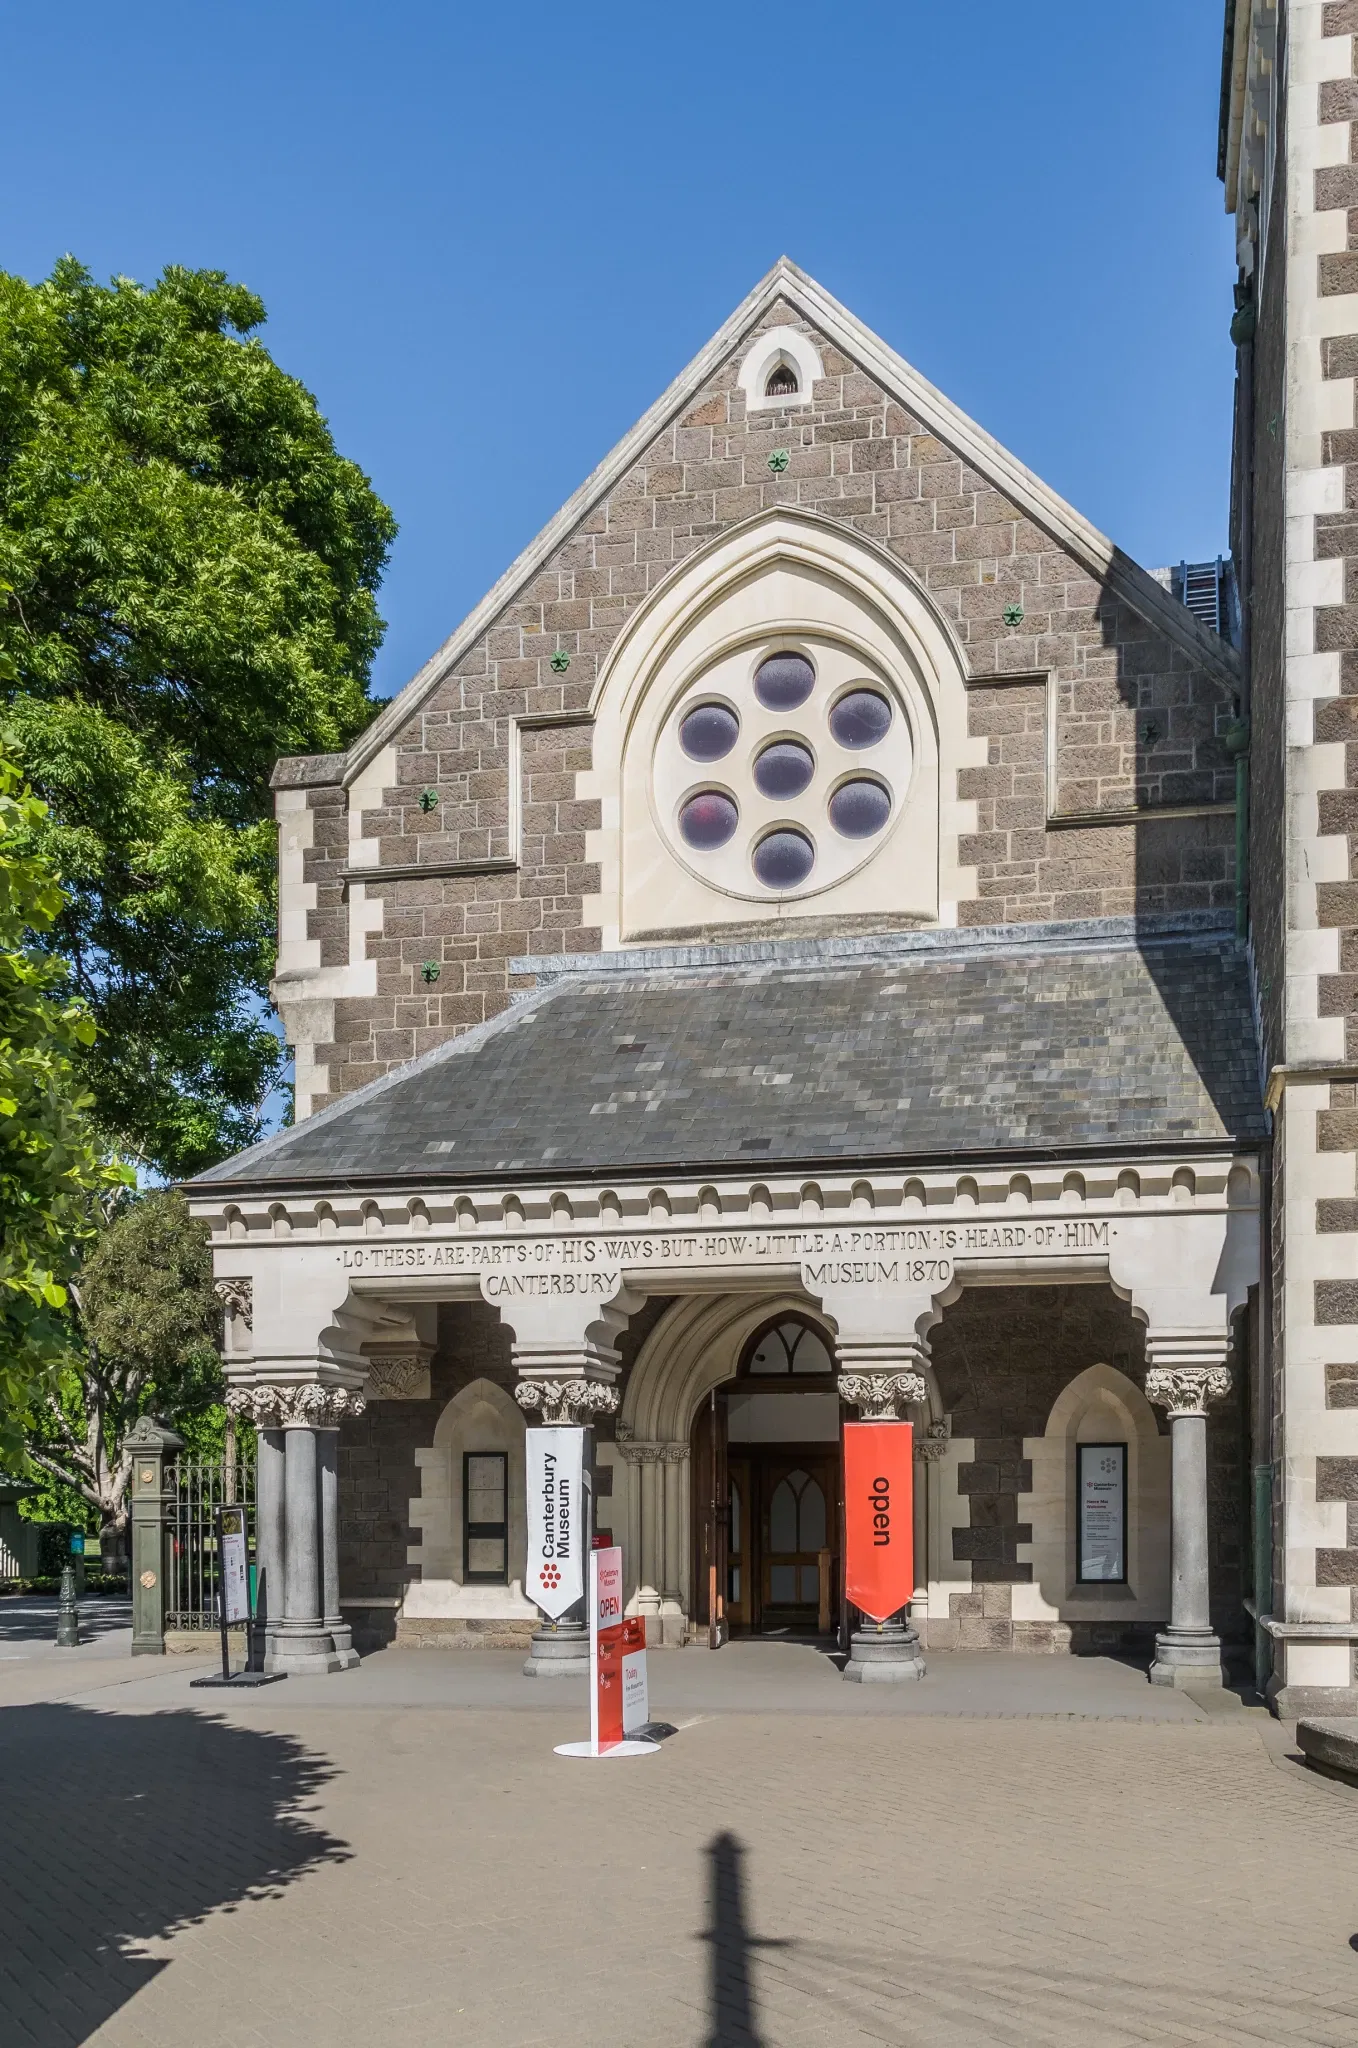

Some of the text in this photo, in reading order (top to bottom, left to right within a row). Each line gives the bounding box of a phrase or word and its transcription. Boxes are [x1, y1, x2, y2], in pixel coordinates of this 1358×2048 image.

[343, 1222, 1110, 1267] LO THESE ARE PARTS OF HIS WAYS BUT HOW LITTLE A PORTION IS HEARD OF HIM
[486, 1273, 618, 1296] CANTERBURY
[805, 1260, 950, 1284] MUSEUM 1870
[542, 1453, 557, 1558] Canterbury
[557, 1479, 570, 1558] Museum
[868, 1477, 890, 1546] open
[600, 1596, 620, 1618] OPEN
